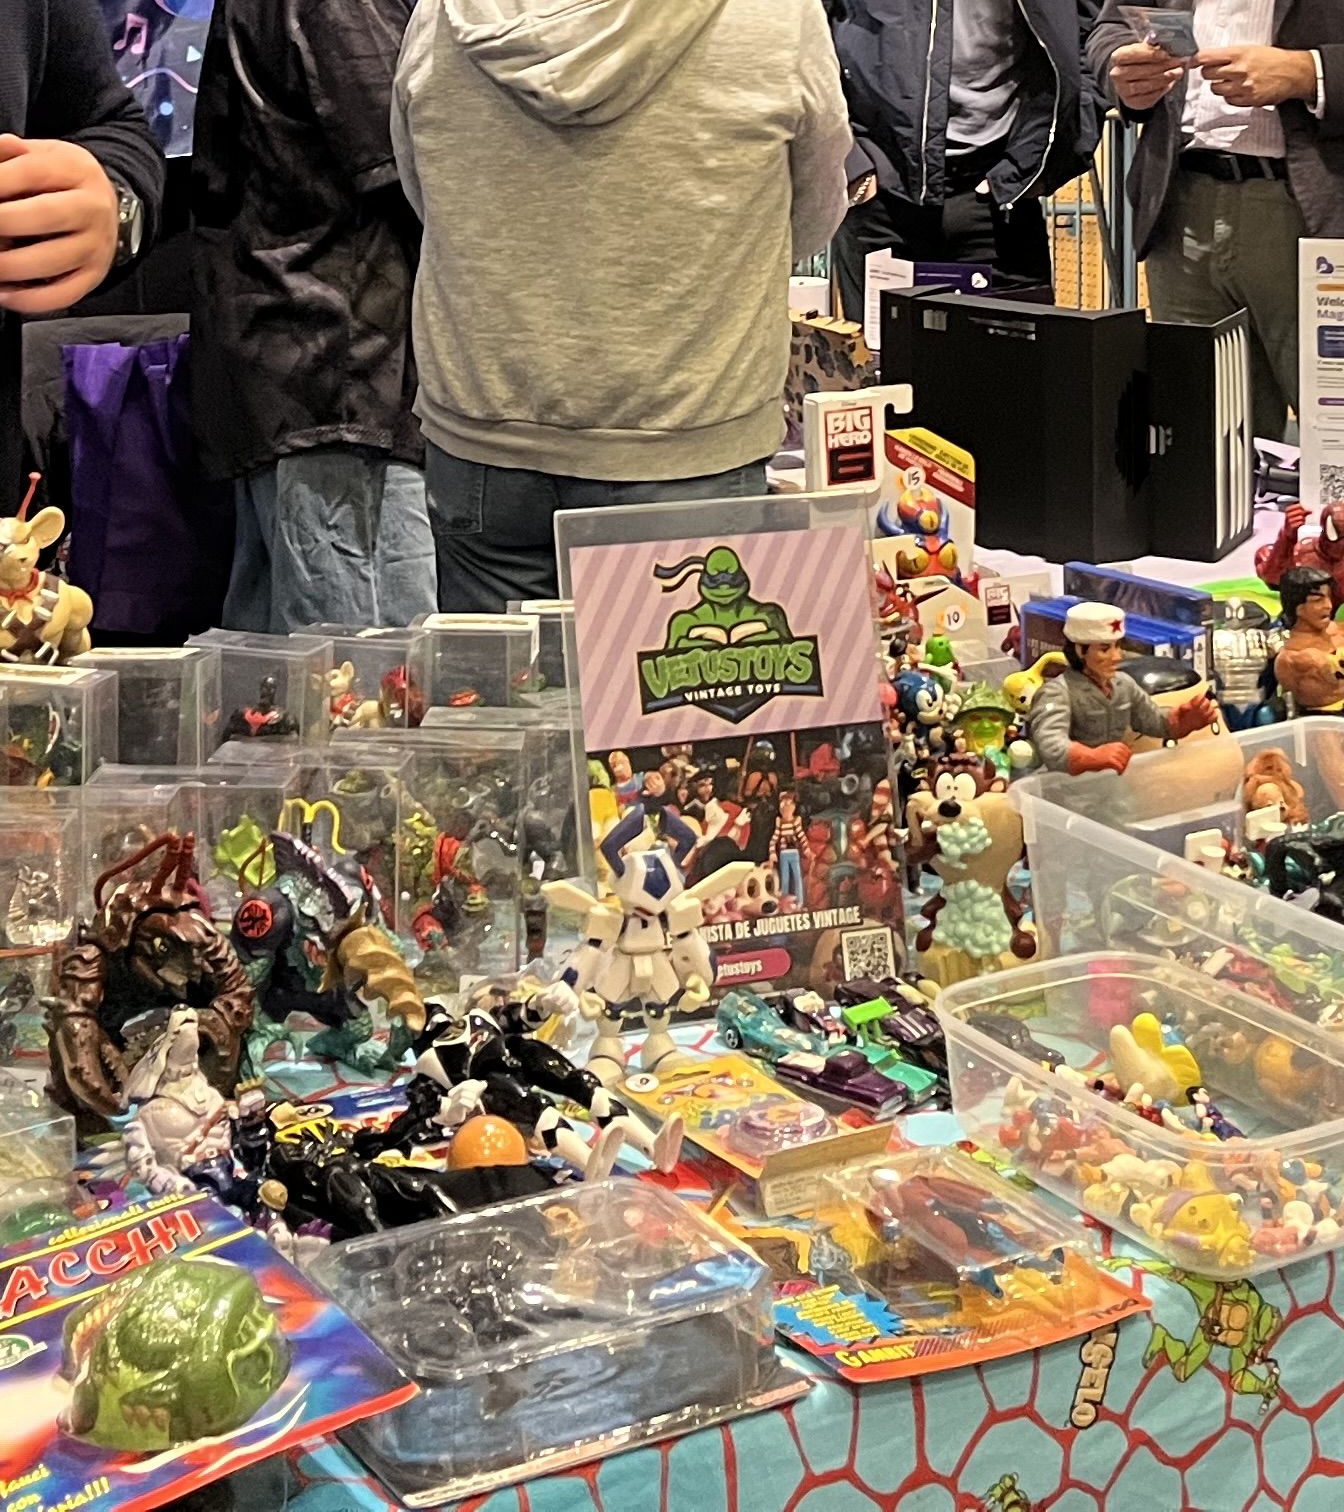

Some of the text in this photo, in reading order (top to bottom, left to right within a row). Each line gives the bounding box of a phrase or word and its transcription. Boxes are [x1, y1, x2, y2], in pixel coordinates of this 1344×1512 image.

[827, 408, 872, 434] BIG
[827, 430, 872, 449] HERO
[641, 640, 815, 699] VETUSTOYS
[684, 682, 782, 702] VINTAGE TOYS
[735, 920, 752, 939] DE
[753, 912, 810, 937] JUGUETES
[812, 905, 862, 929] VINTAGE
